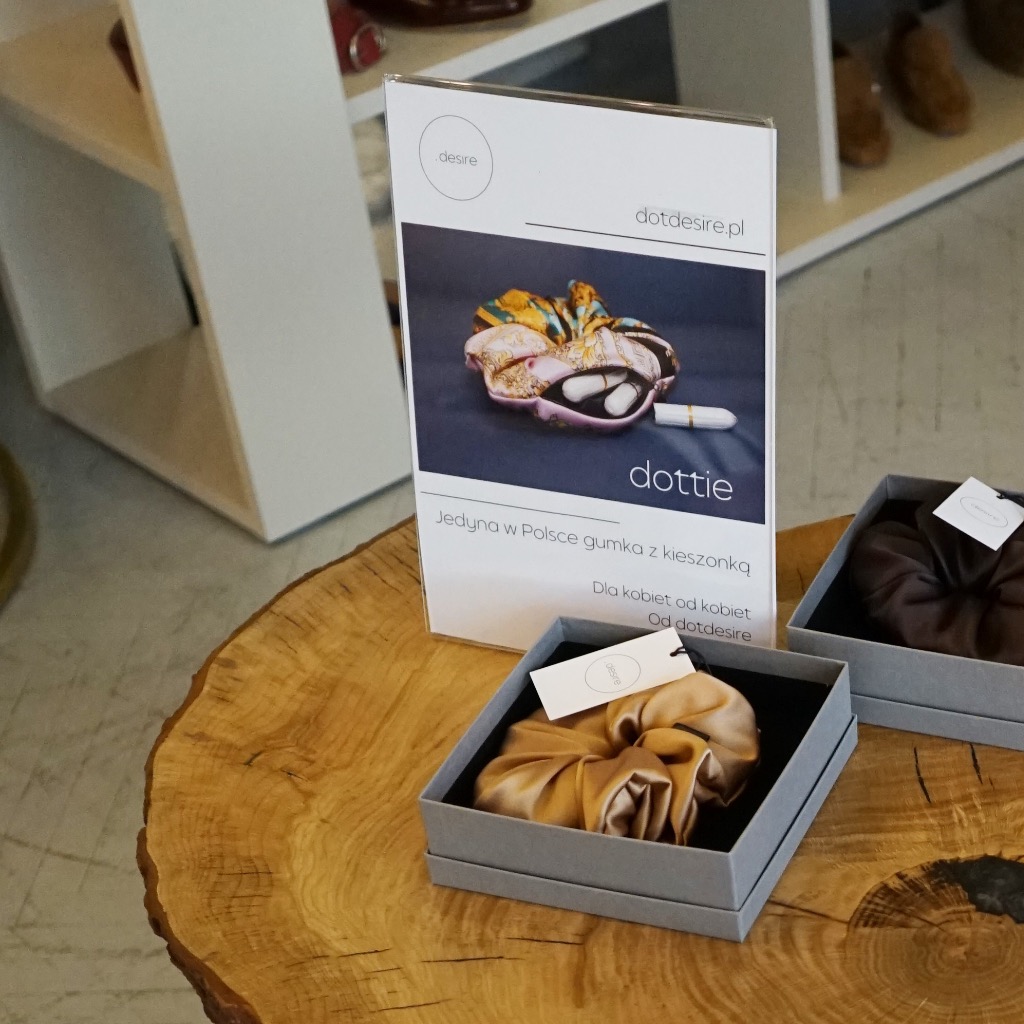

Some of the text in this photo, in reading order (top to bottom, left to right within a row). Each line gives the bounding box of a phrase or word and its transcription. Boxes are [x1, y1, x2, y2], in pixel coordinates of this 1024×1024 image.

[635, 206, 745, 238] dotdesire.pl
[629, 459, 734, 501] dottie
[435, 510, 752, 578] Jedyna w Polsce gumka z kieszonką
[592, 580, 752, 619] Dla kobiet od kobiet
[648, 612, 752, 642] Od dotdesire
